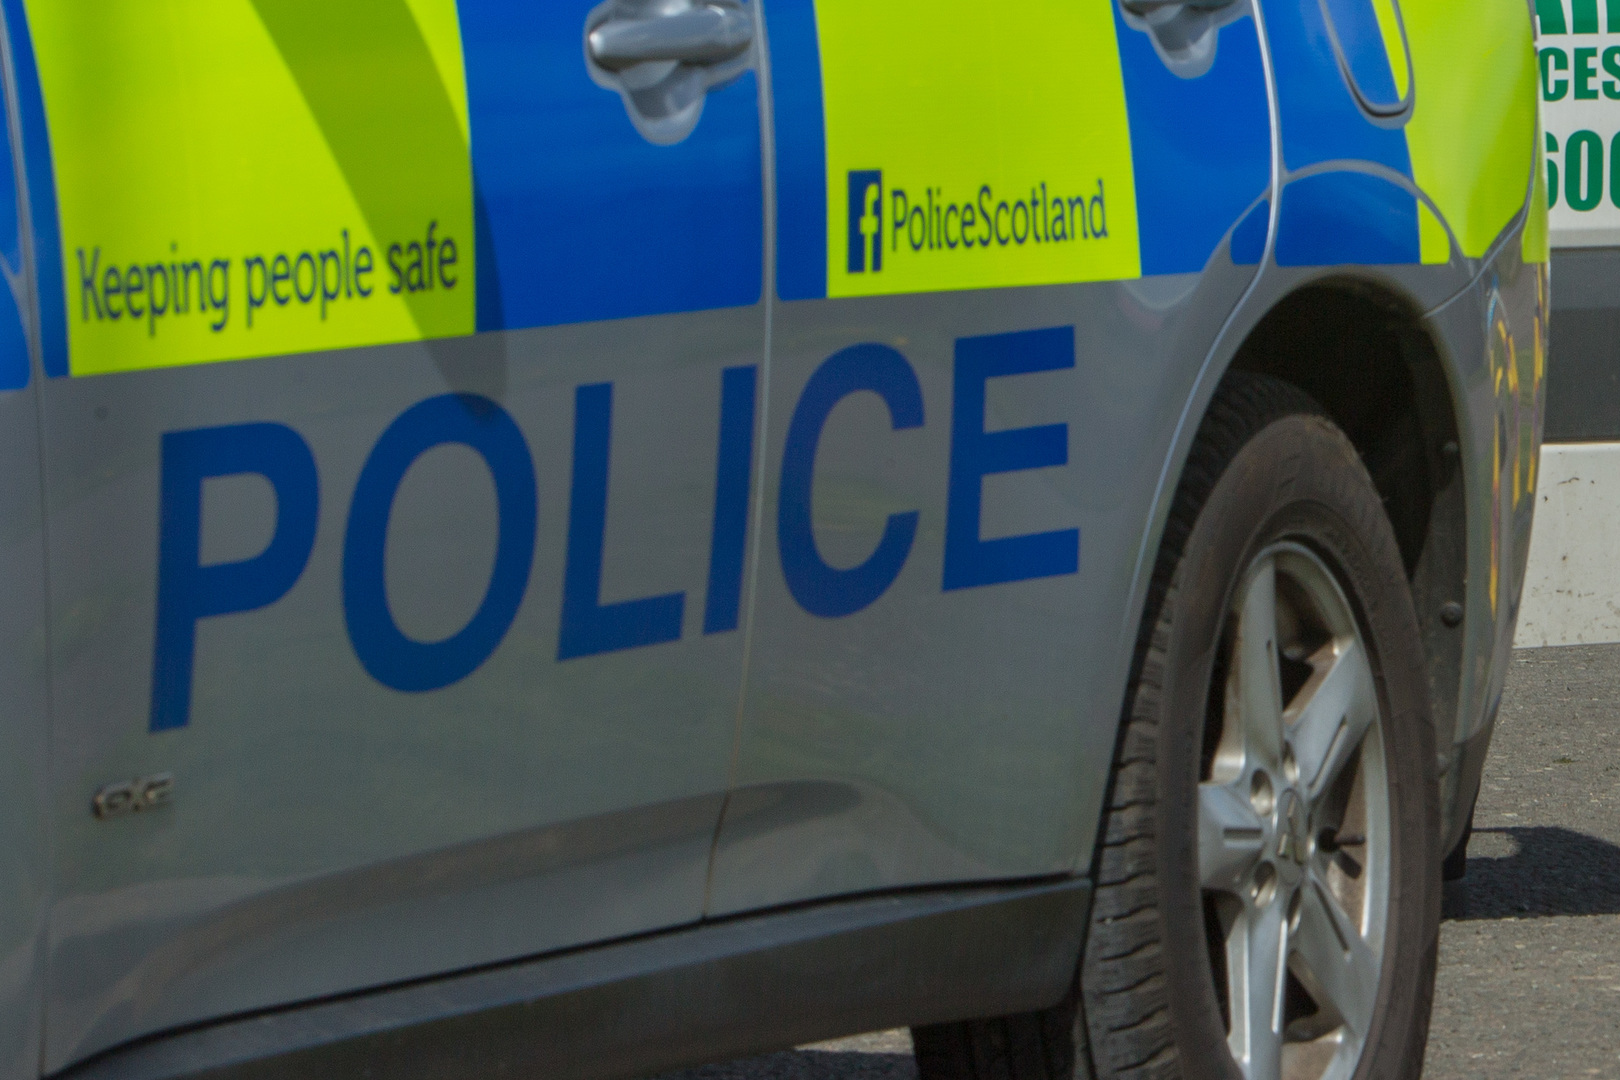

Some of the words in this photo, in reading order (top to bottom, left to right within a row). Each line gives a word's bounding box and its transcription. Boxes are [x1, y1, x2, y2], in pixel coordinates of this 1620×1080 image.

[891, 177, 1109, 252] PoliceScotland
[76, 242, 231, 338] Keeping
[243, 228, 374, 329] people
[387, 220, 458, 294] safe
[148, 325, 1080, 734] POLICE
